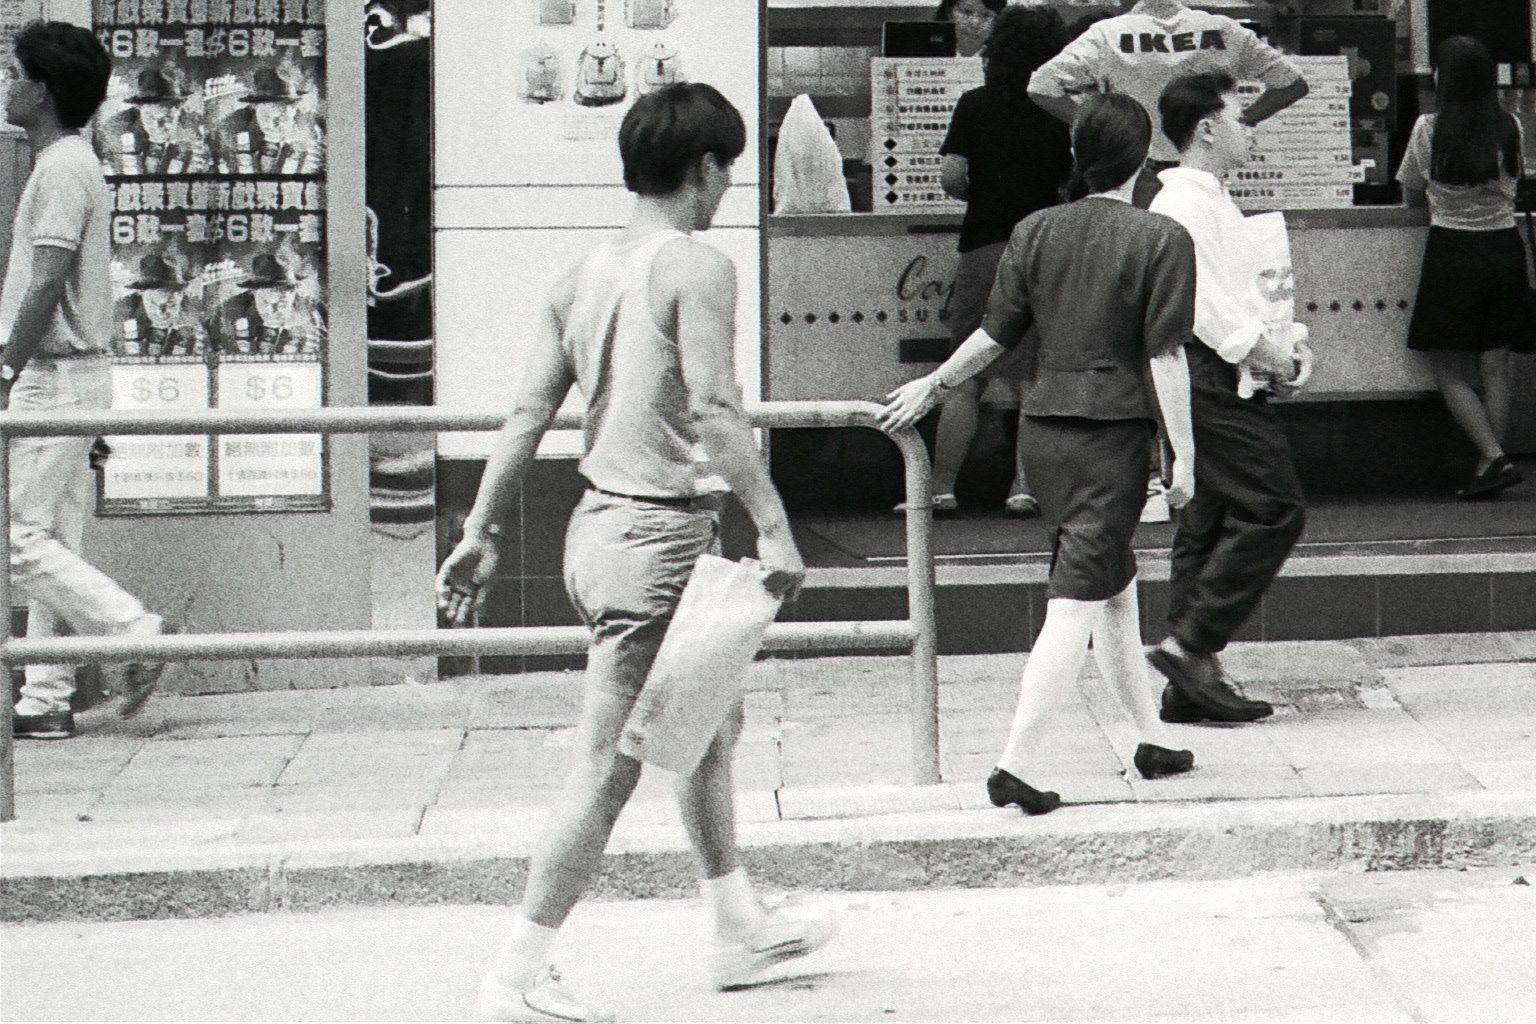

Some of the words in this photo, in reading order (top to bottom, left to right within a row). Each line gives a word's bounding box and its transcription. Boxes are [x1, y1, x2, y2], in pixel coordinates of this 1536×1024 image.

[1120, 29, 1227, 53] IKEA
[131, 377, 180, 403] $6
[246, 375, 293, 401] $6
